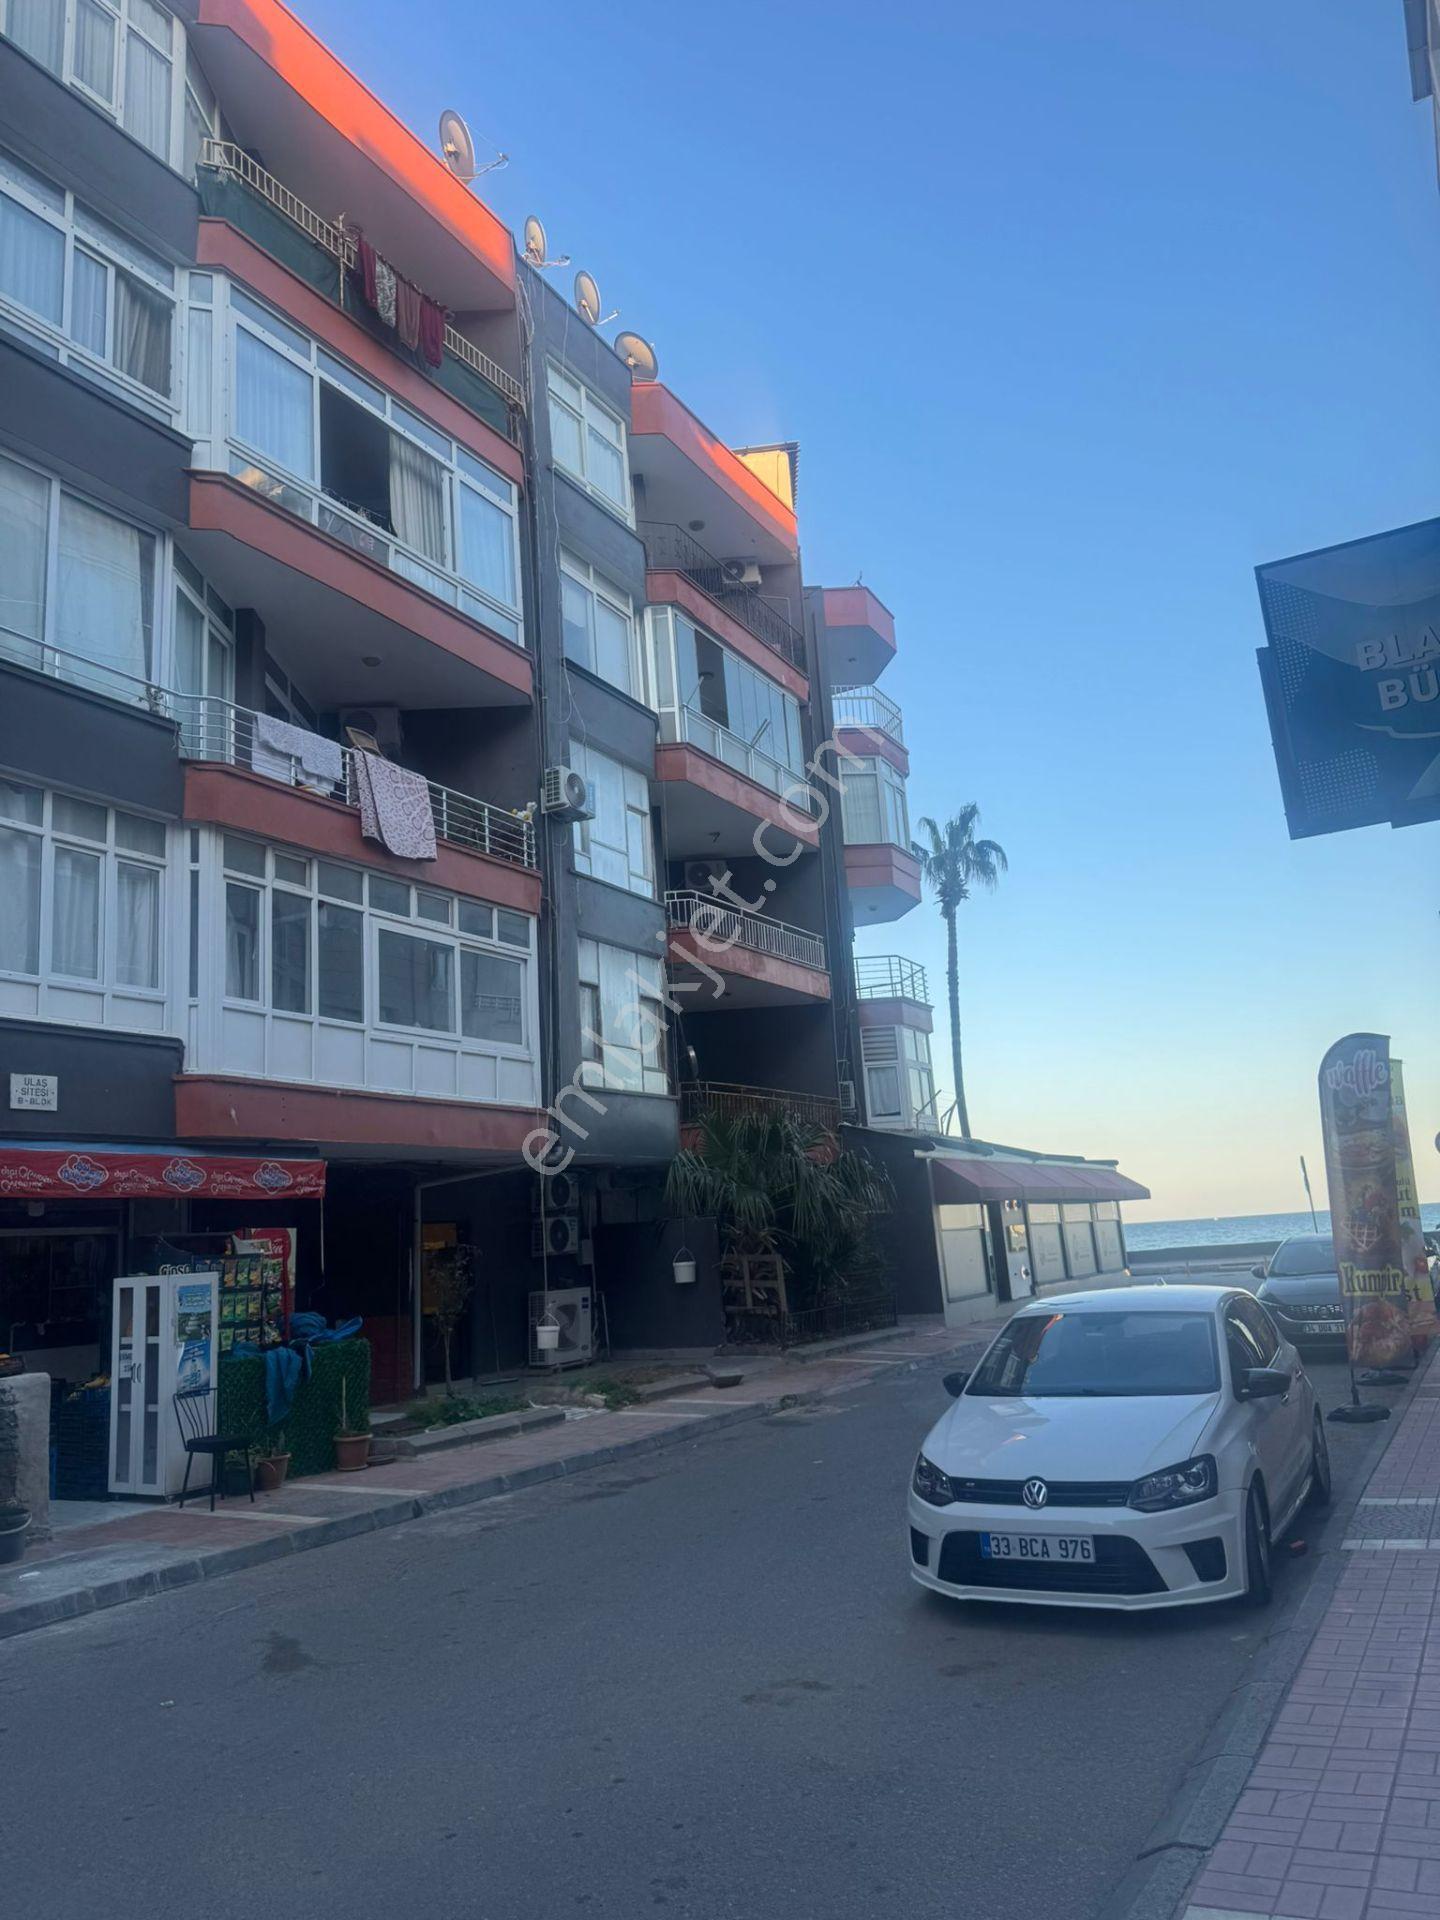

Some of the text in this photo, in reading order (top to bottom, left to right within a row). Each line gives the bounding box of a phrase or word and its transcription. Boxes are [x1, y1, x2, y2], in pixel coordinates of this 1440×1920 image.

[1355, 624, 1440, 672] BLA
[1377, 664, 1440, 711] BÜ
[24, 1077, 48, 1088] ULAŞ
[1326, 1049, 1387, 1096] waffle
[991, 1536, 1092, 1559] 33 BCA 976
